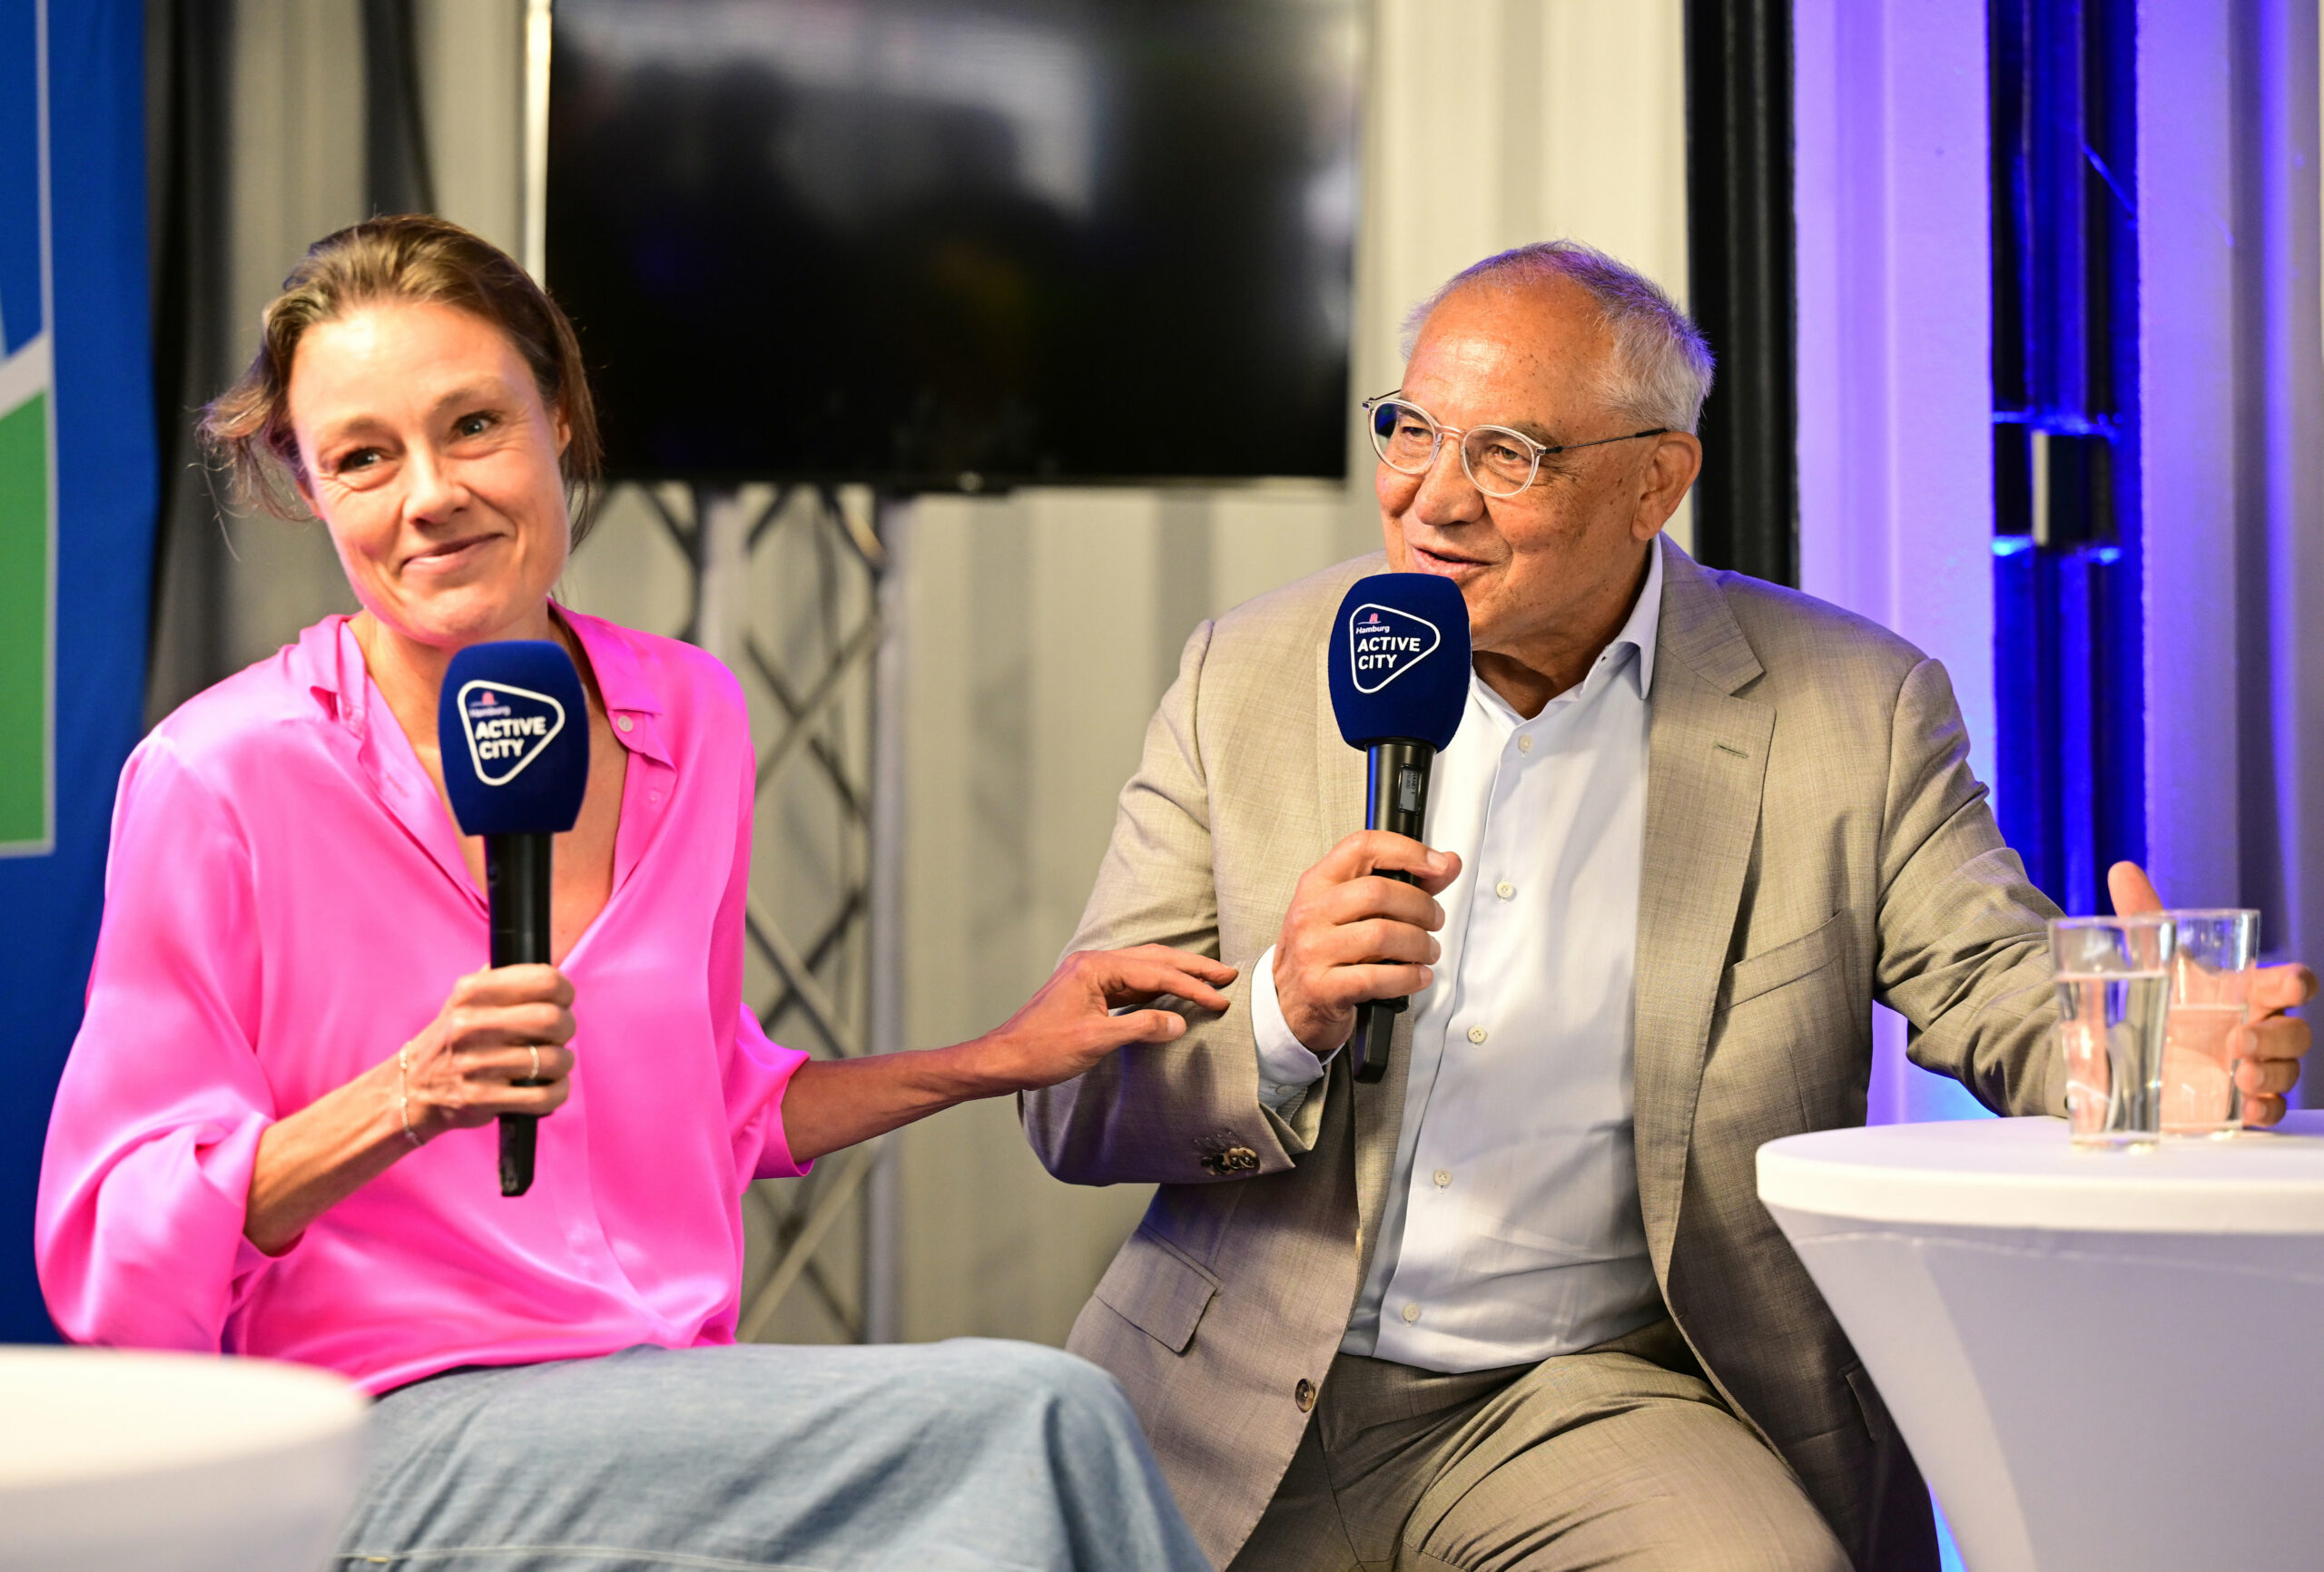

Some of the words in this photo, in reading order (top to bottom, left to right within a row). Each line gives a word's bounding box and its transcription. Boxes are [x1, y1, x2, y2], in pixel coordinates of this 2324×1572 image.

[1355, 625, 1390, 634] Hamburg
[1357, 636, 1421, 653] ACTIVE
[1358, 653, 1397, 670] CITY
[475, 716, 547, 740] ACTIVE
[478, 739, 525, 760] CITY
